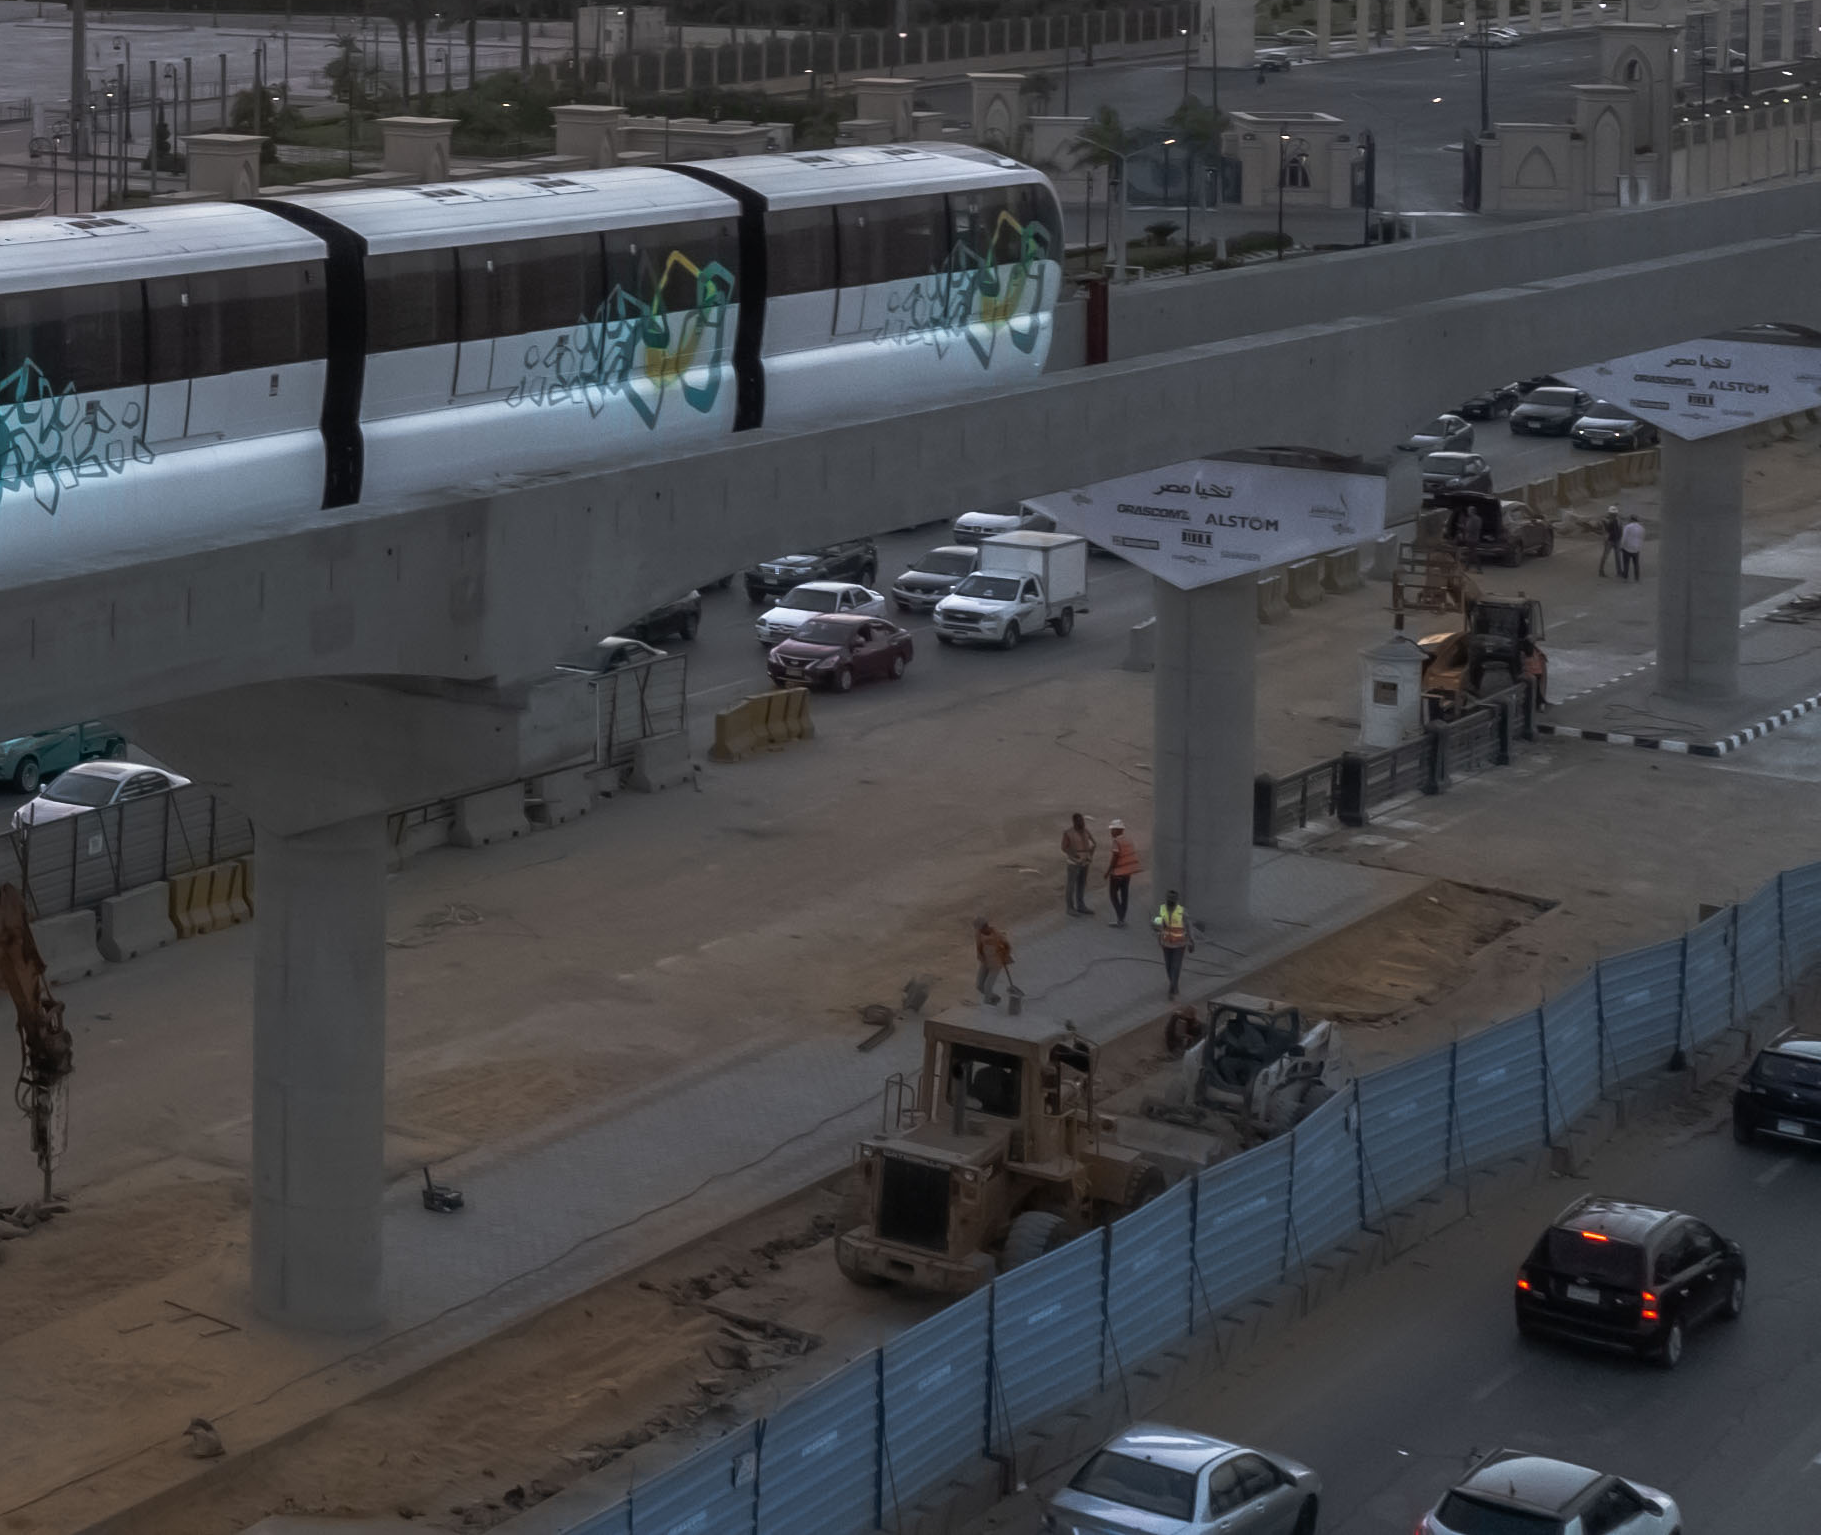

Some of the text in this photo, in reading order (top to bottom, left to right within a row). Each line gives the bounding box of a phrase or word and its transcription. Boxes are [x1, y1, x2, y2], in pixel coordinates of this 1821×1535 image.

[1664, 354, 1732, 369] تحيا مصر
[1708, 380, 1770, 394] ALSTOM
[1152, 480, 1235, 500] تحيا مصر
[1204, 513, 1279, 532] ALSTOM
